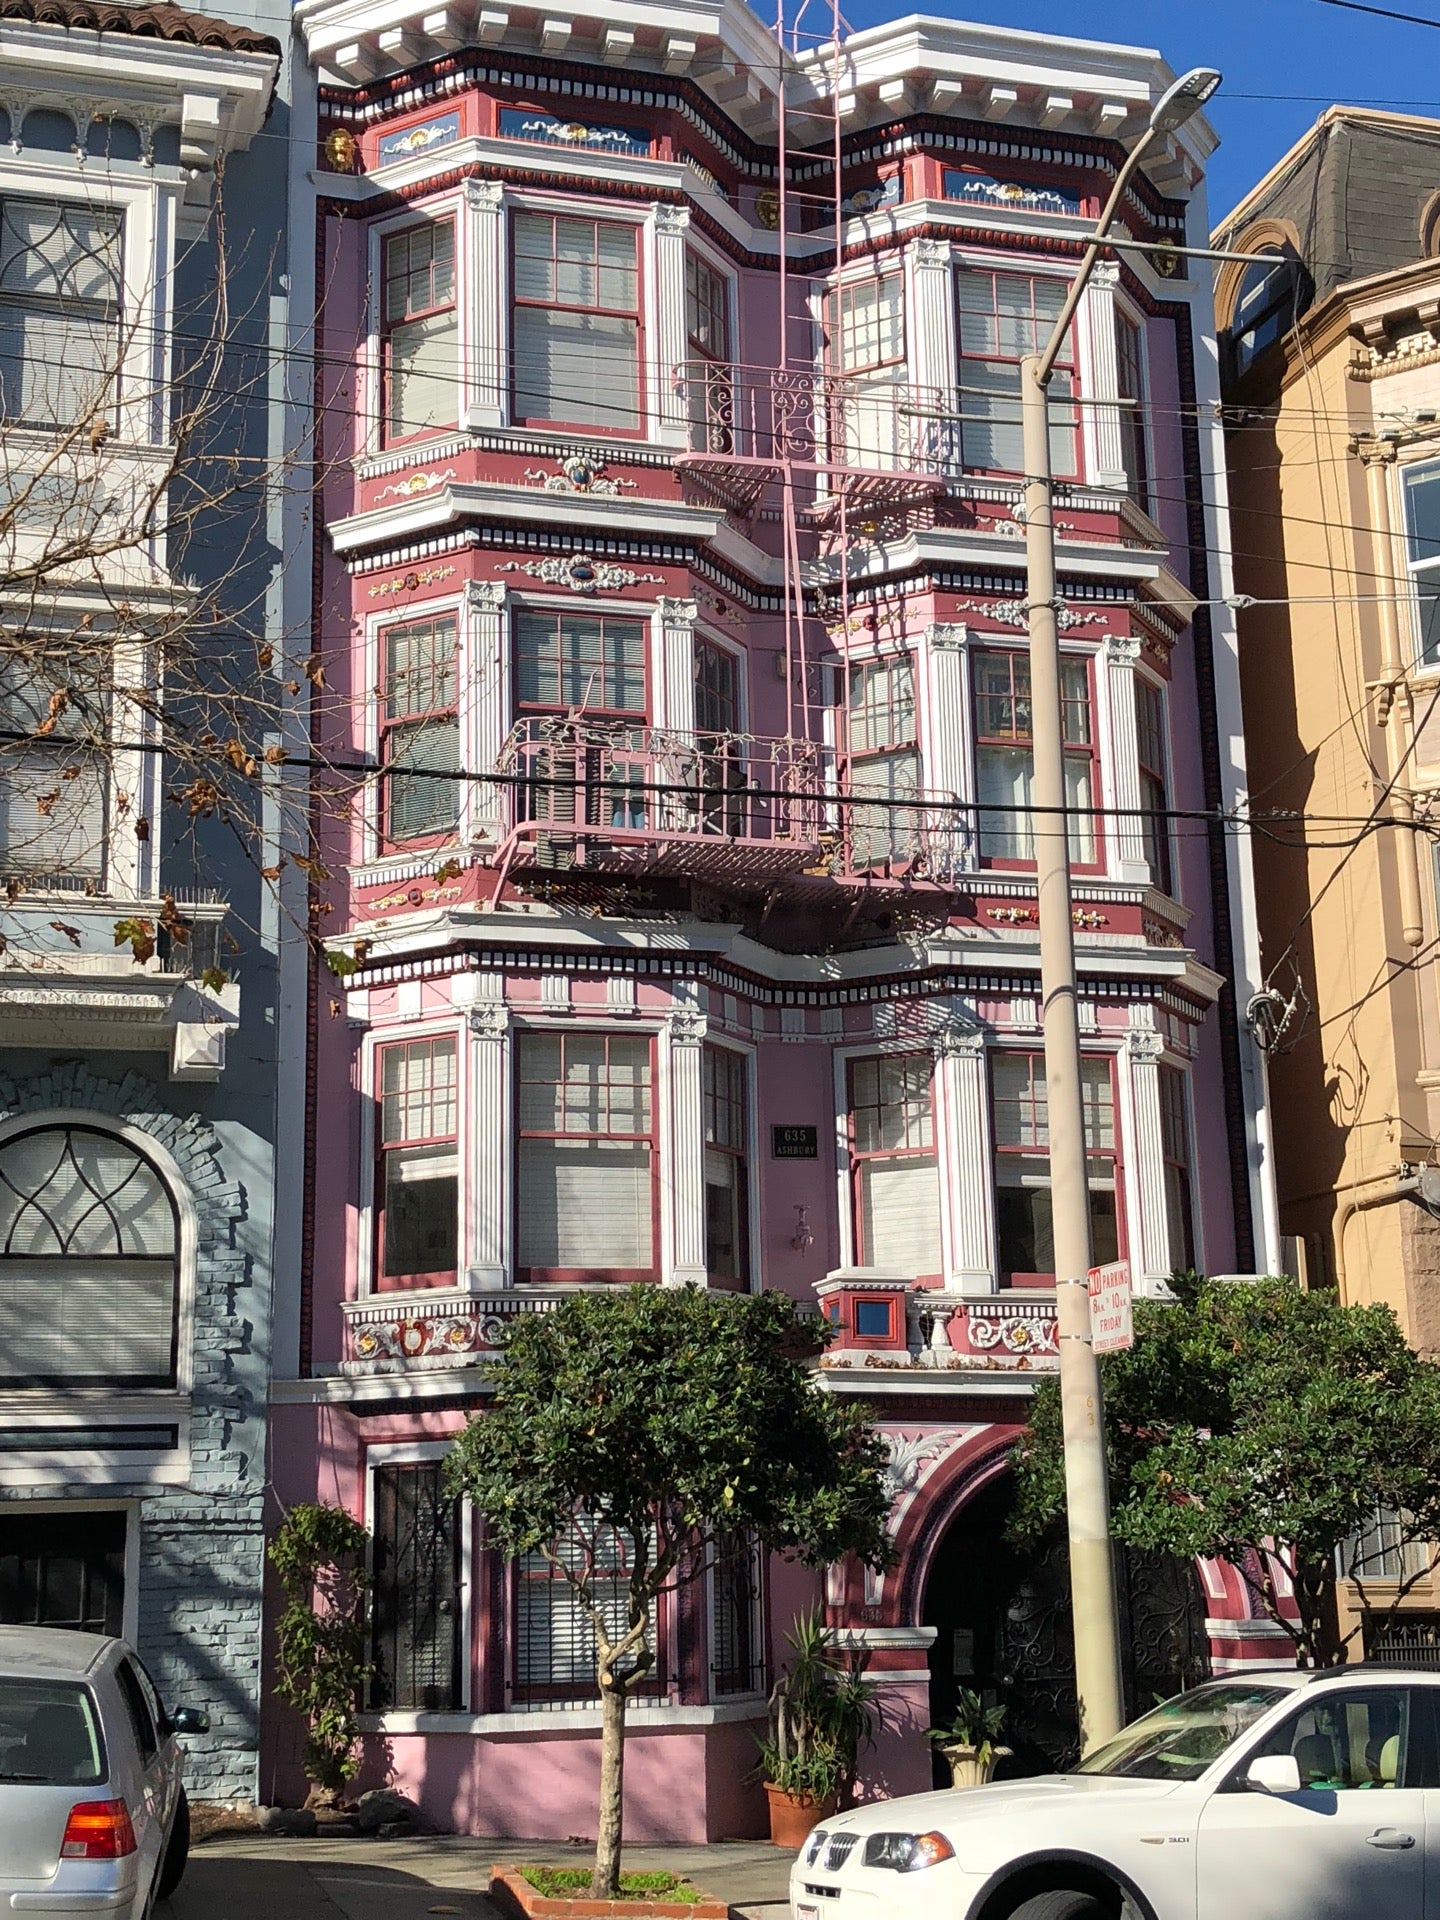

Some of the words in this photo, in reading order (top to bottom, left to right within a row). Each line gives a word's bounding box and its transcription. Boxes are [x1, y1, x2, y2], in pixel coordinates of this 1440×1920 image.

[784, 1129, 806, 1142] 635
[777, 1145, 815, 1155] ASHBURY
[1089, 1271, 1101, 1295] NO
[1102, 1268, 1128, 1290] PARKING
[1100, 1315, 1121, 1332] FRIDAY
